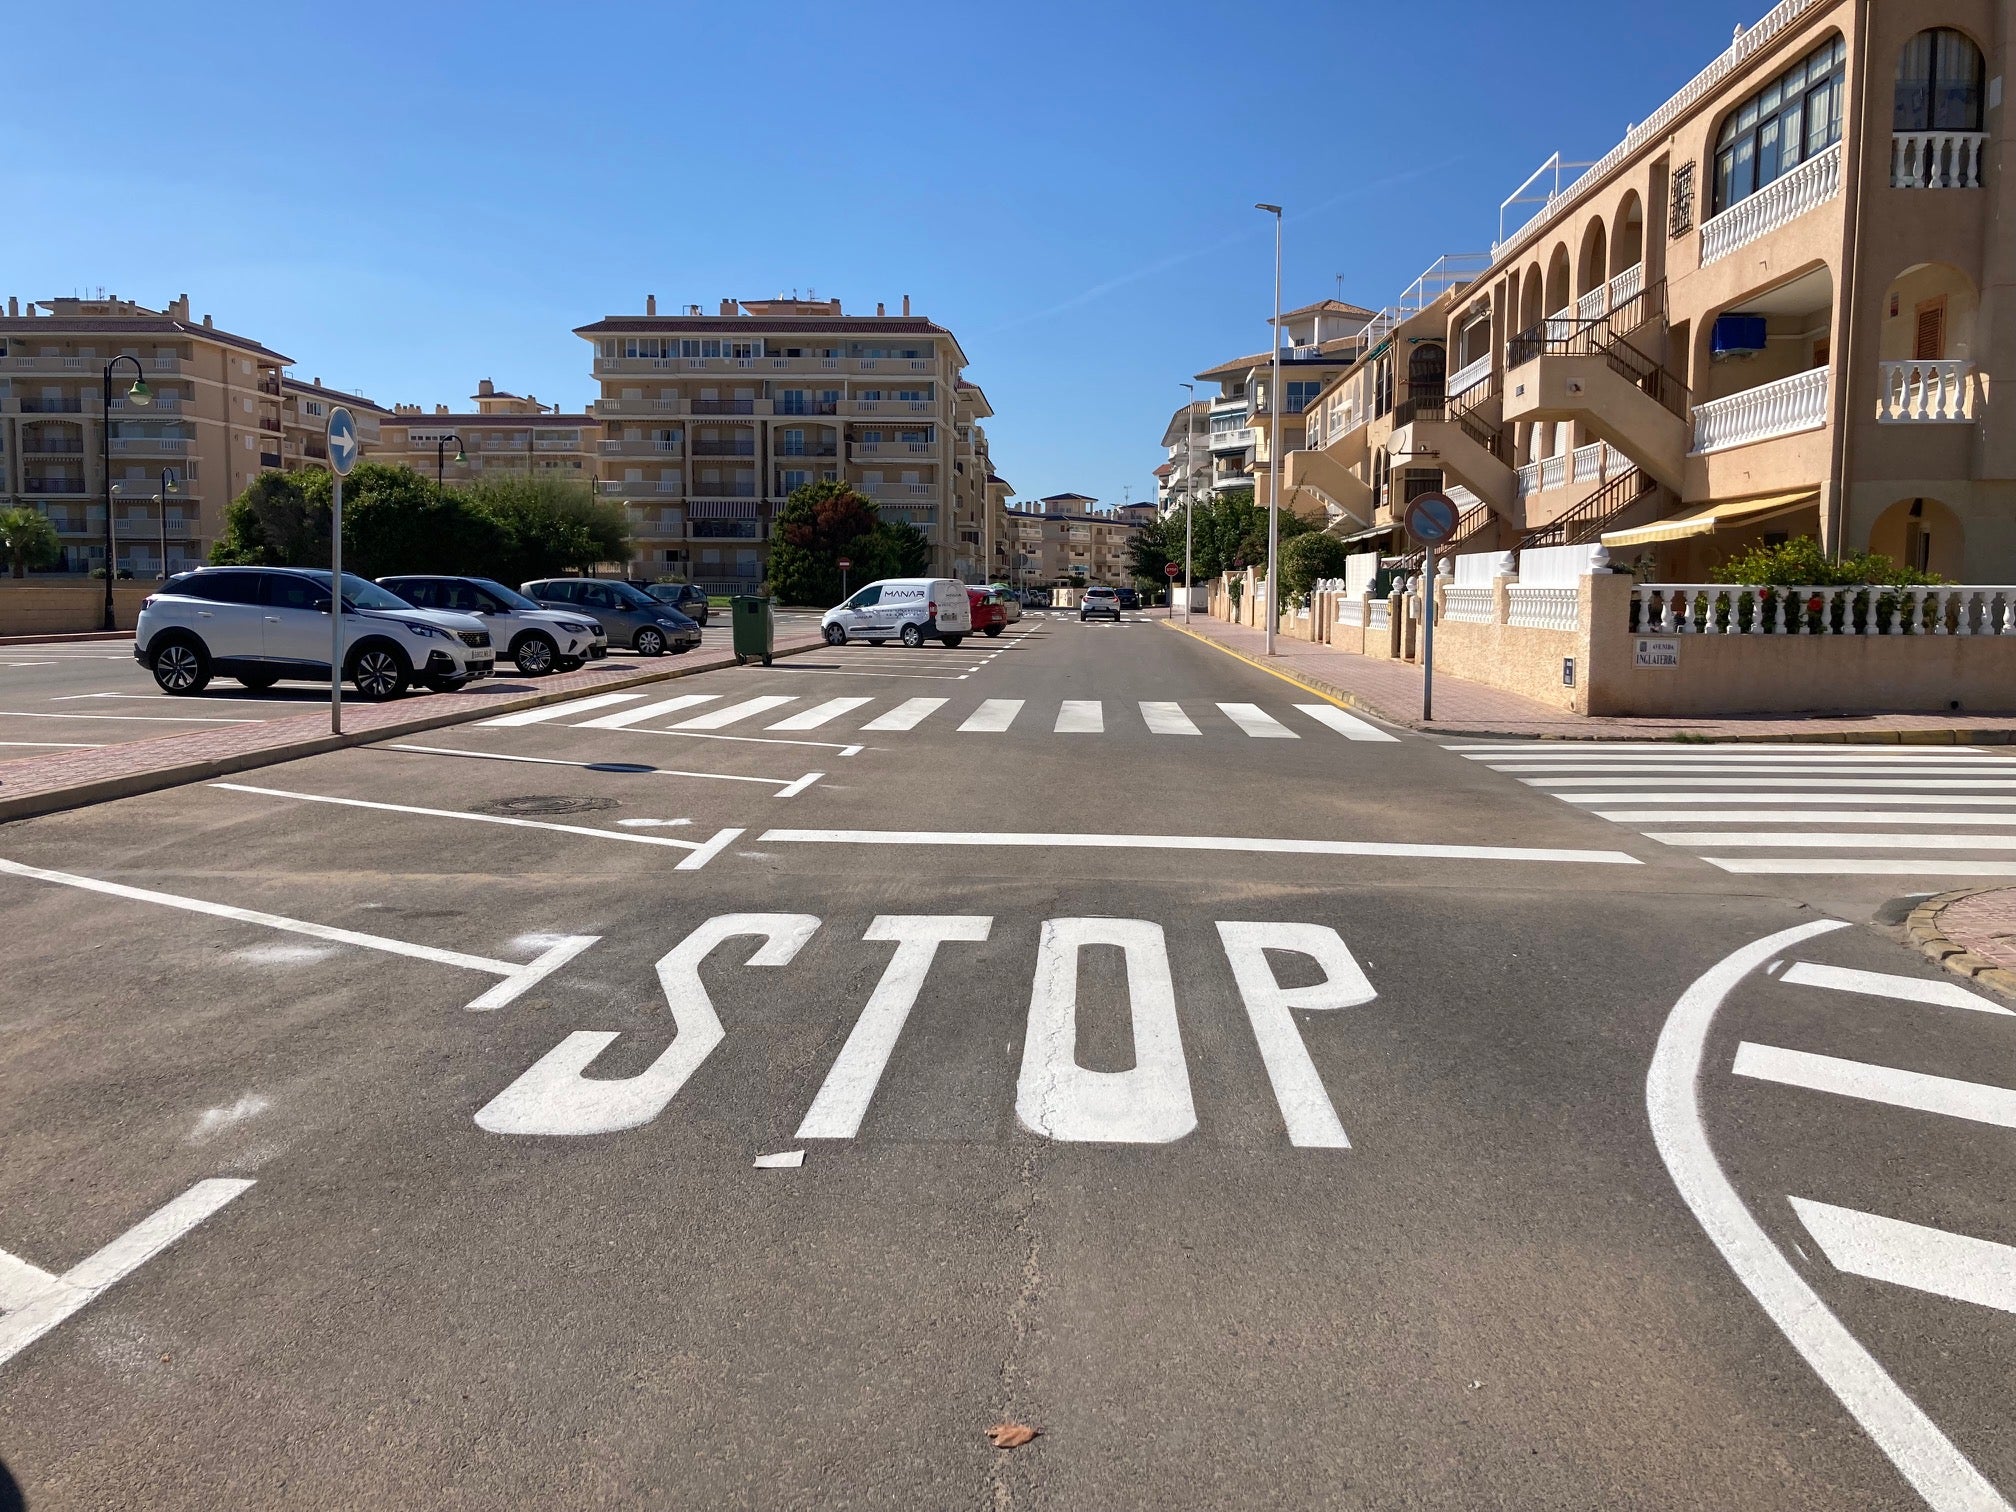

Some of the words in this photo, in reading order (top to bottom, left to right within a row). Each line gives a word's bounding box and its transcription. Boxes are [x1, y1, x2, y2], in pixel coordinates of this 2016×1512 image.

[884, 590, 925, 598] MANAR
[1636, 654, 1677, 665] INGLATERRA
[473, 912, 1378, 1150] STOP
